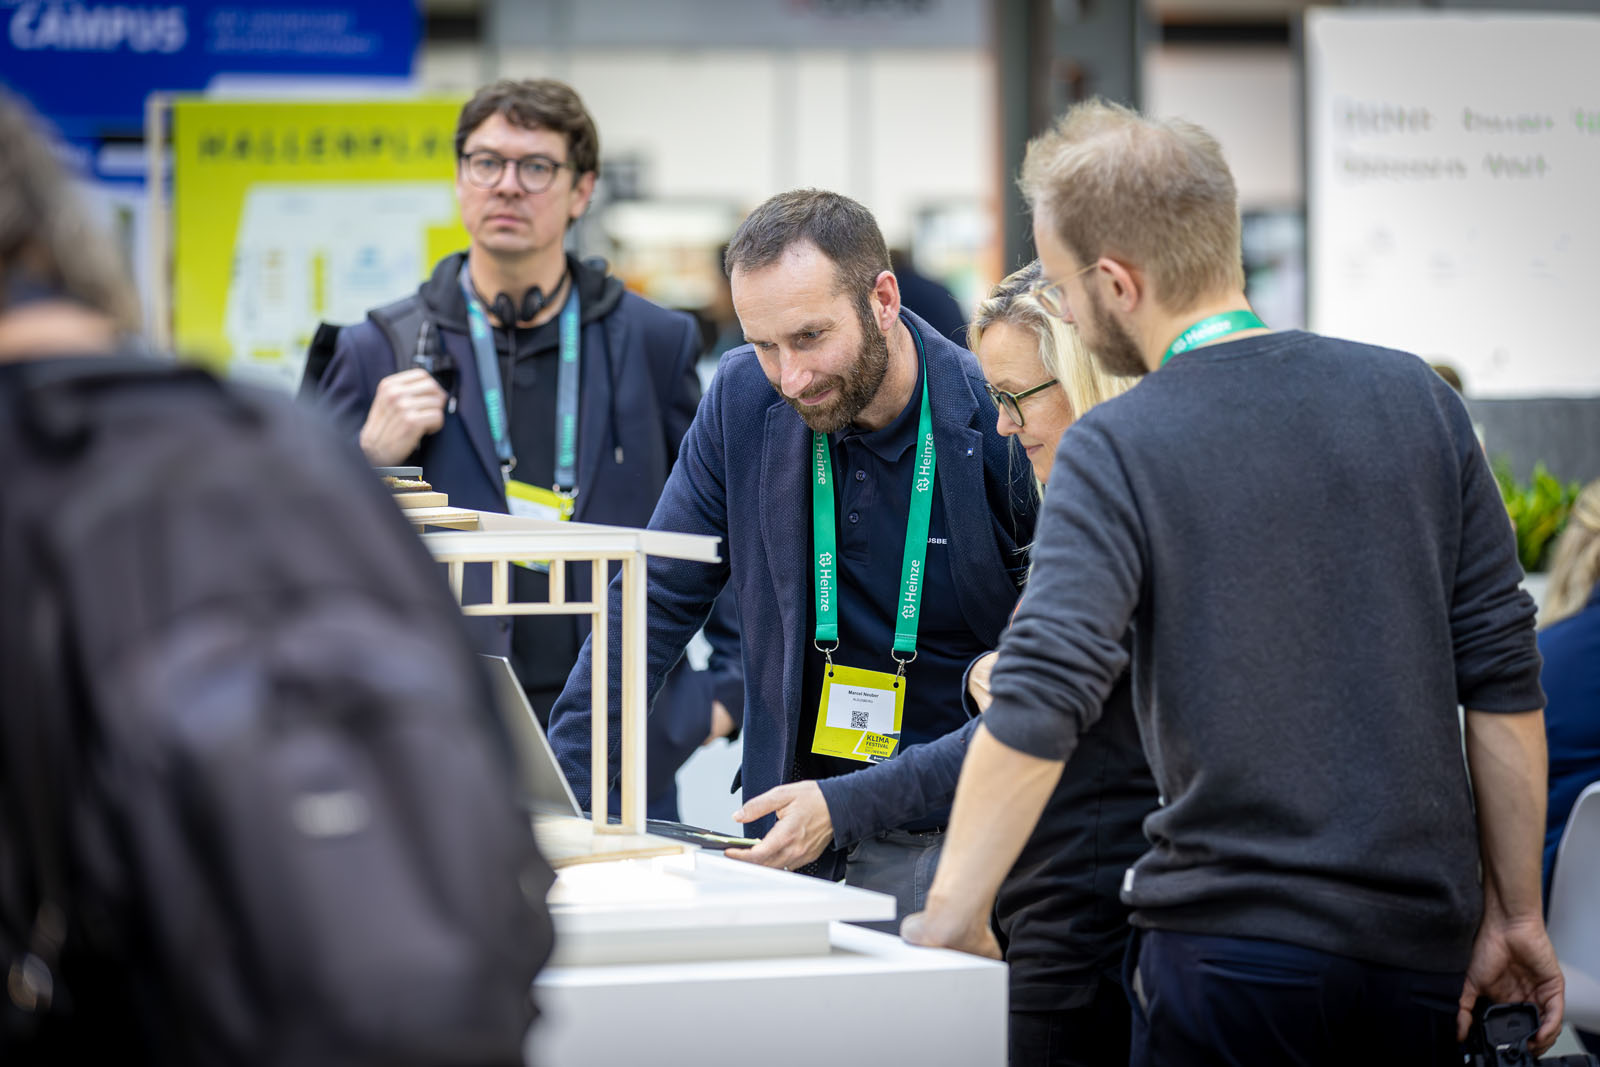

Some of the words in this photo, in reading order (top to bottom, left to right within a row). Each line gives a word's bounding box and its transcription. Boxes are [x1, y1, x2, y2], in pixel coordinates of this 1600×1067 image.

[197, 127, 455, 164] HALLENPLA
[816, 442, 827, 485] Heinze
[919, 432, 934, 475] Heinze
[820, 569, 833, 612] Heinze
[904, 559, 921, 602] Heinze
[865, 741, 889, 749] FESTIVAL
[866, 735, 889, 744] KLIMA
